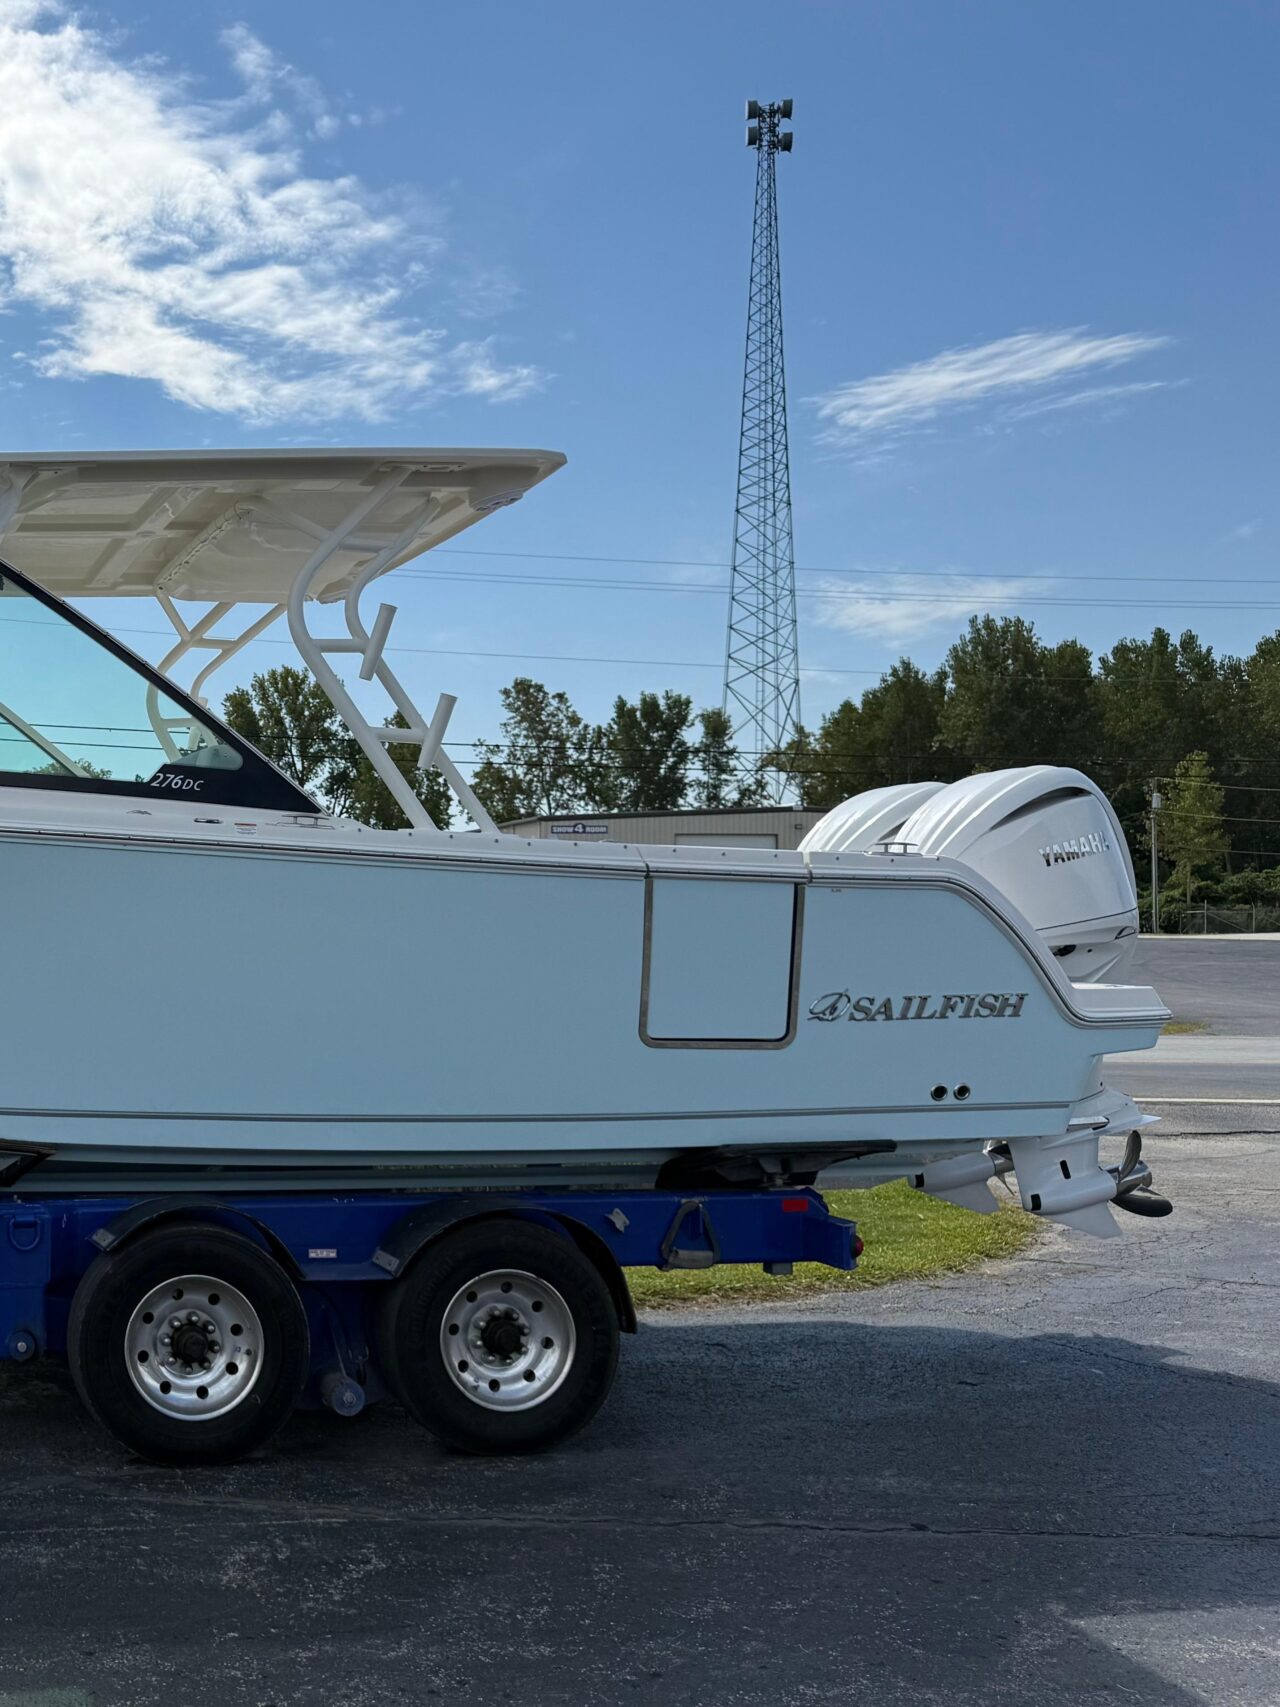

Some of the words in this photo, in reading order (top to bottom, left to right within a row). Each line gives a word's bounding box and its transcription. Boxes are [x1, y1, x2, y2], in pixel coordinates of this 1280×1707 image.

[574, 823, 584, 833] 4
[1039, 831, 1110, 867] YAMAHA
[848, 993, 1029, 1021] SAILFISH
